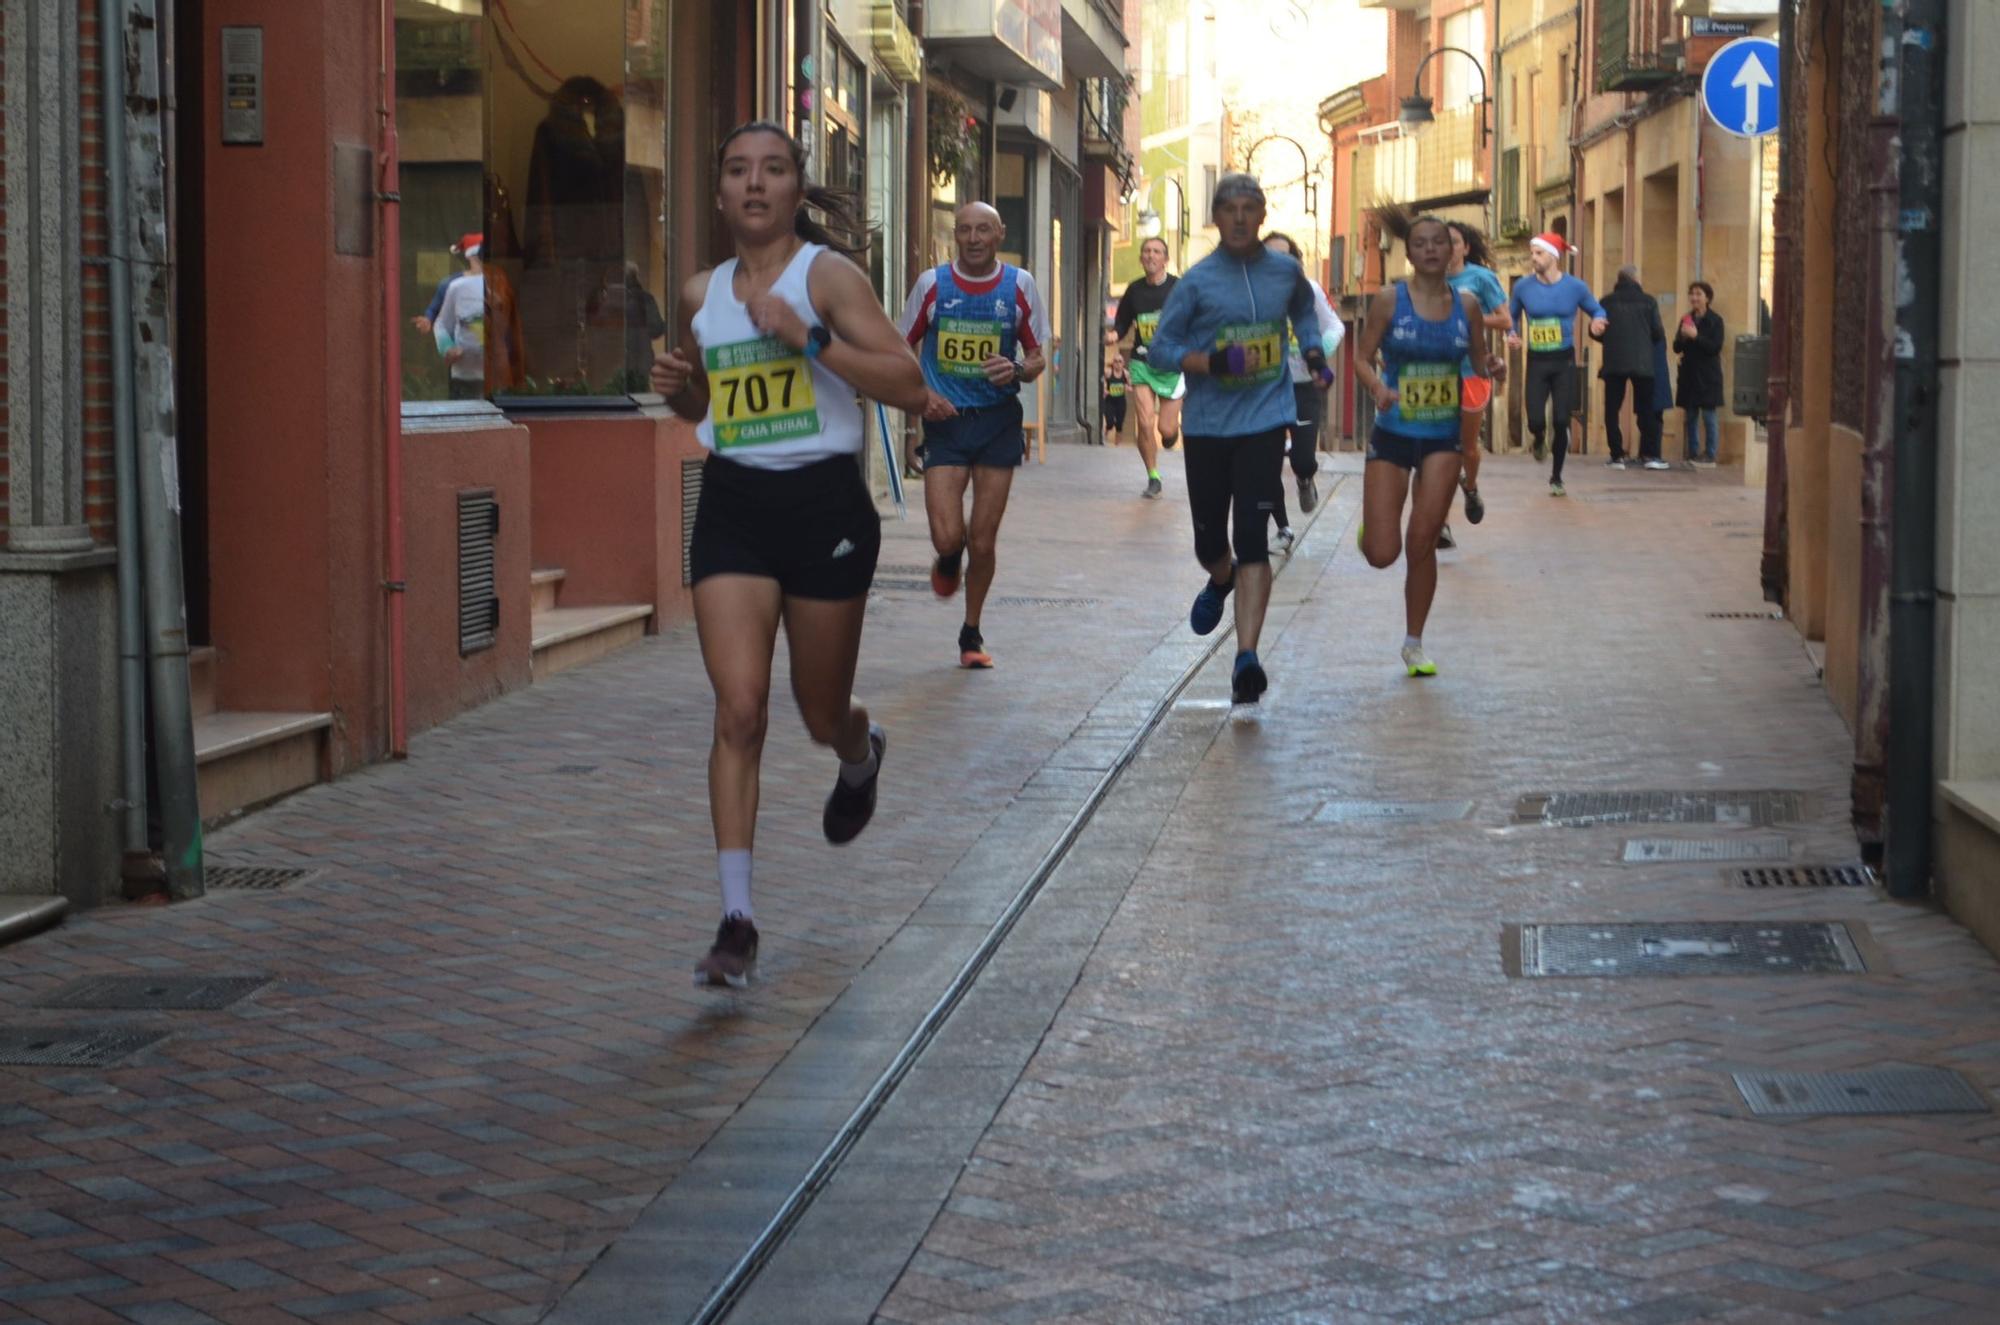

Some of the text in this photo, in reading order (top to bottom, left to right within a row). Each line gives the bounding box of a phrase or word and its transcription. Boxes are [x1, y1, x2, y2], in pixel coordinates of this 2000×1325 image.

[943, 337, 993, 362] 650
[720, 368, 796, 418] 707
[770, 416, 813, 435] RURAL
